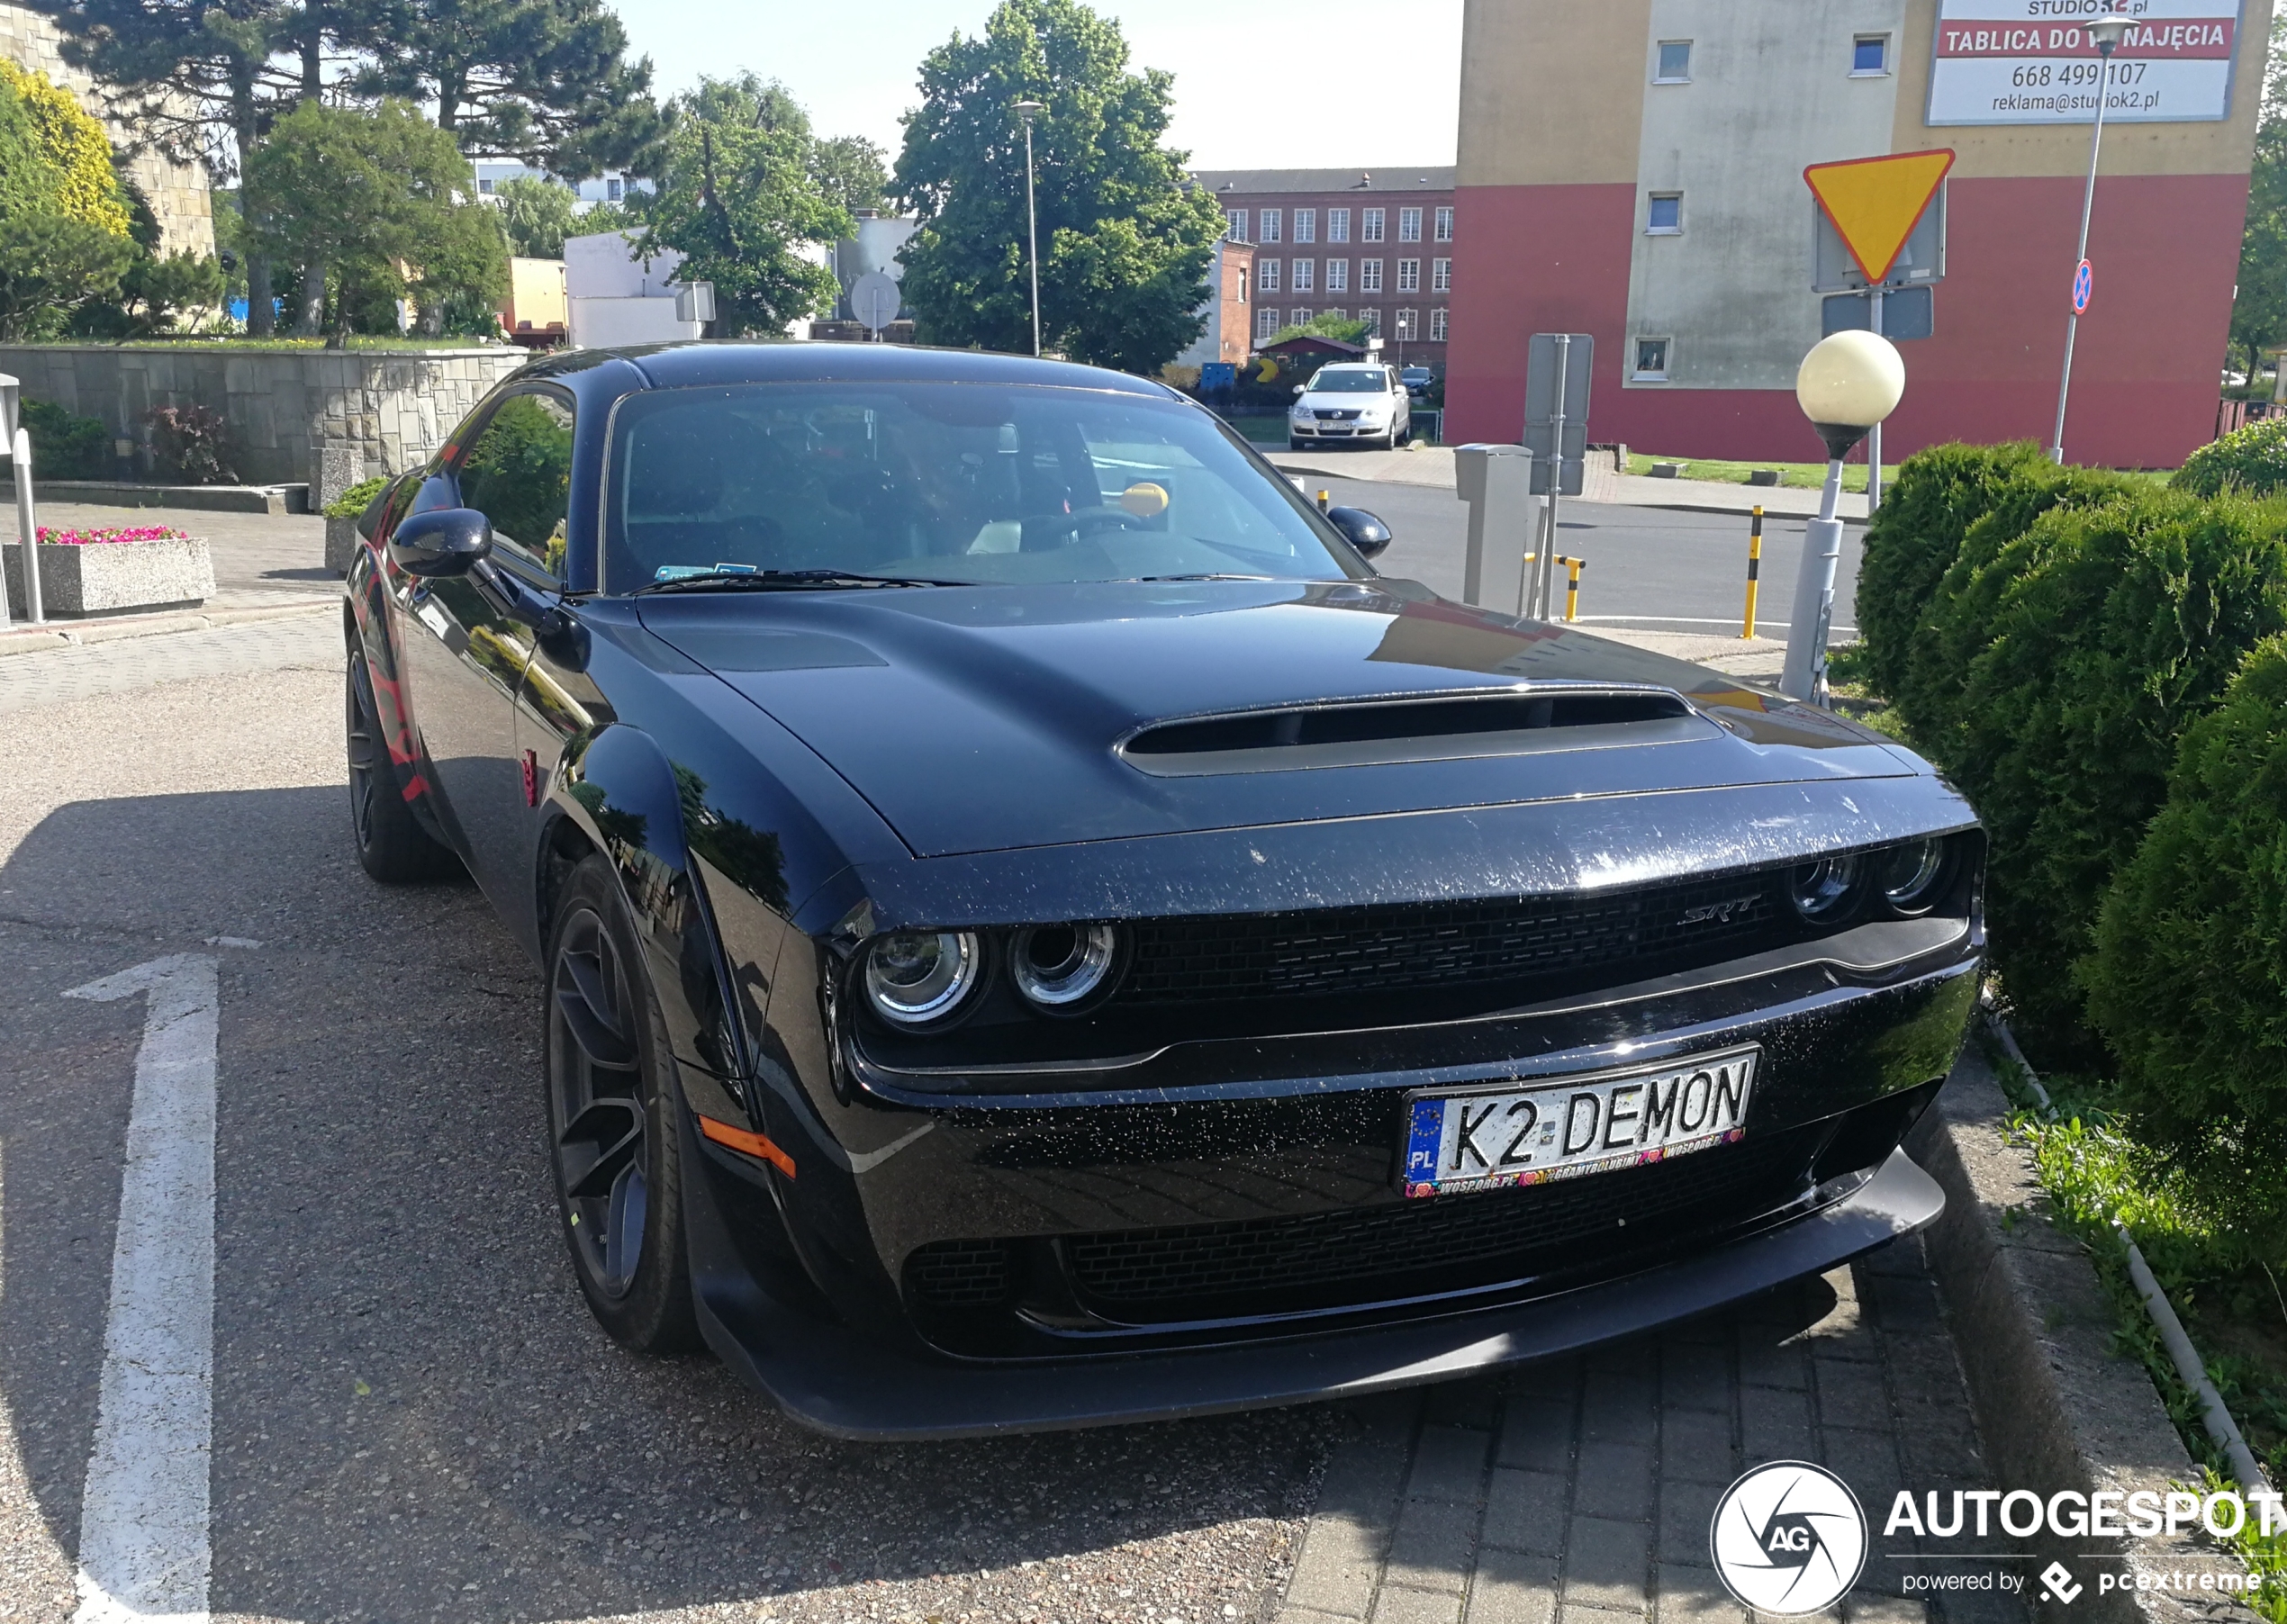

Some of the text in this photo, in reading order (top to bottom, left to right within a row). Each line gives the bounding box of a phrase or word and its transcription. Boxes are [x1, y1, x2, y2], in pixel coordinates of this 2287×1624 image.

[1947, 25, 2224, 51] TABLICA DO NAJĘCIA
[2011, 63, 2147, 87] 668 499 107
[1993, 91, 2159, 113] reklama@stuiok2.pl
[1677, 894, 1762, 925] SRT
[1455, 1060, 1749, 1170] K2 DEMON
[1411, 1150, 1433, 1168] PL
